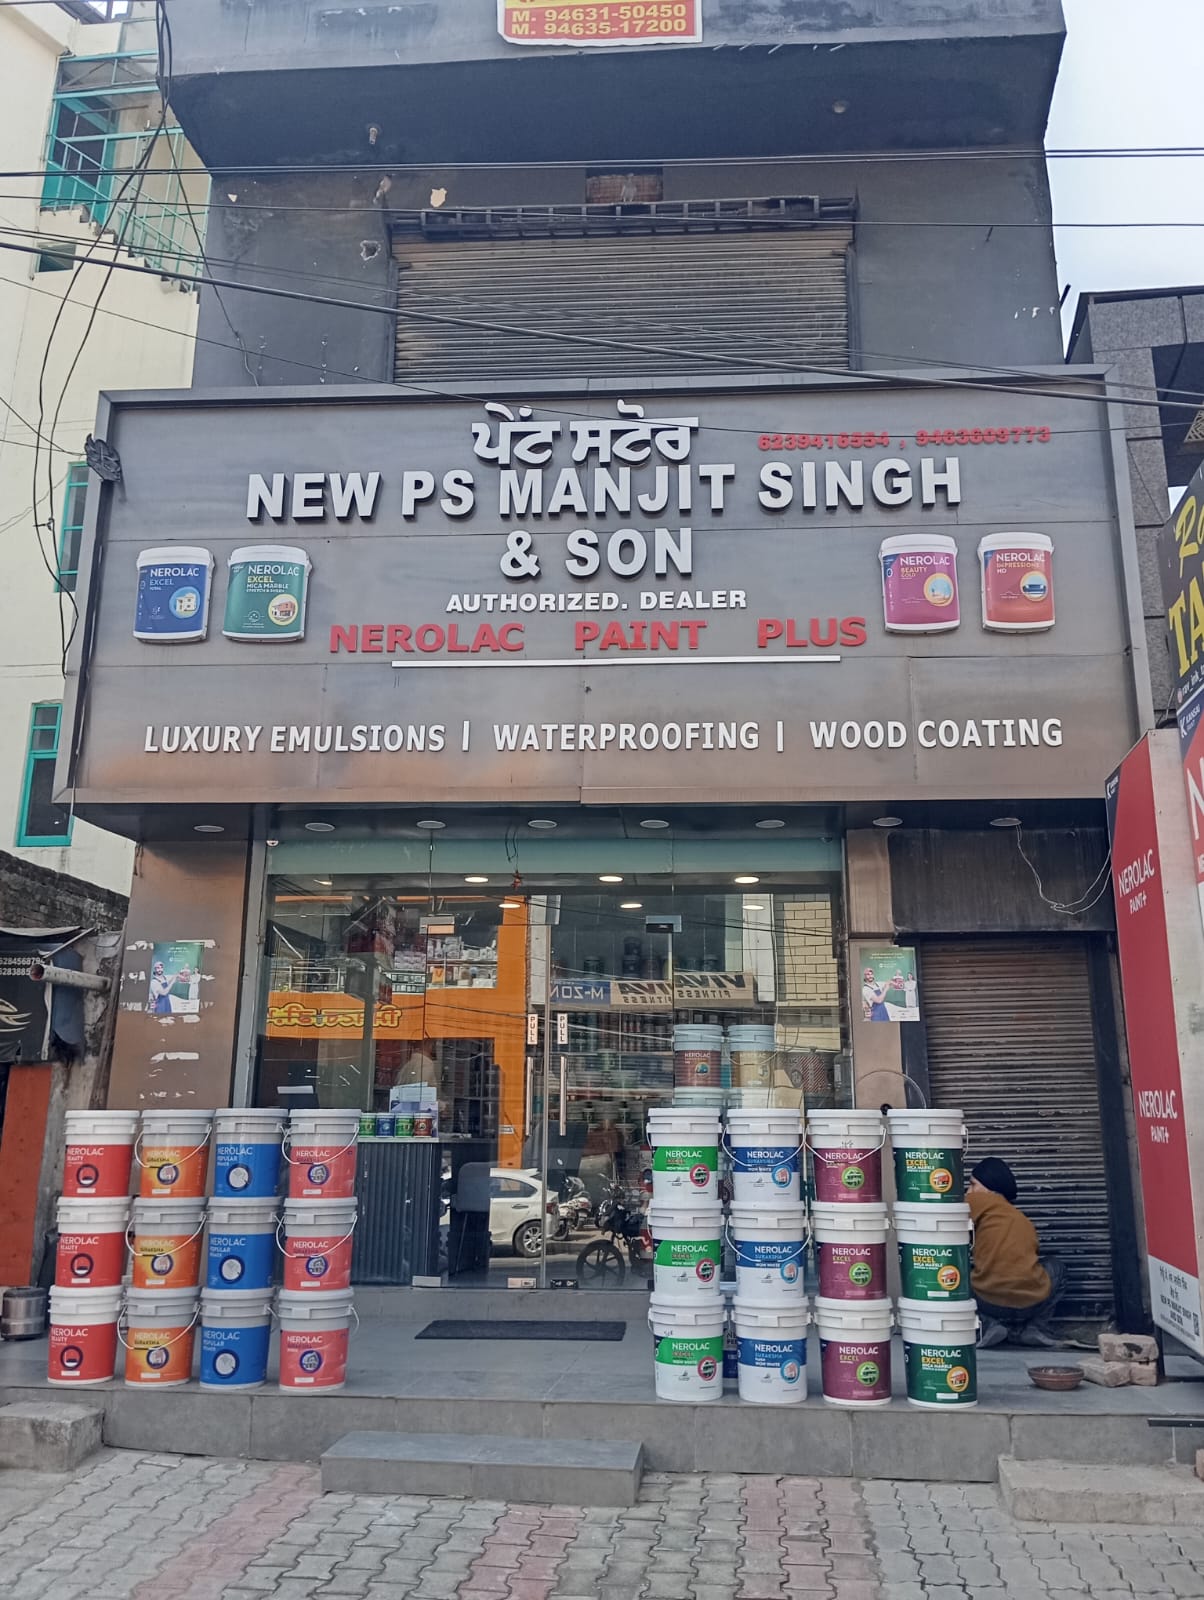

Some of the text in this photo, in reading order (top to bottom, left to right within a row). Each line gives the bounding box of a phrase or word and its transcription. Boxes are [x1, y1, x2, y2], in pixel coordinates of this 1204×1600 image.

[511, 4, 687, 23] M. 94631-50450
[511, 19, 687, 36] M. 94635-17200
[246, 456, 962, 518] NEW PS MANJIT SINGH
[500, 527, 693, 579] & SON
[996, 552, 1046, 563] NEROLAC
[900, 555, 950, 567] NEROLAC
[150, 567, 200, 578] NEROLAC
[247, 564, 300, 577] NEROLAC
[900, 566, 928, 574] BEAUTY
[149, 578, 175, 586] EXCEL
[247, 575, 275, 583] EXCEL
[445, 589, 748, 613] AUTHORIZED. DEALER
[329, 616, 868, 653] NEROLAC PAINT PLUS
[144, 725, 263, 753] LUXURY
[270, 724, 447, 753] EMULSIONS
[492, 722, 760, 752] WATERPROOFING
[809, 720, 908, 751] WOOD
[917, 718, 1064, 749] COATING
[1118, 848, 1156, 899] NEROLAC
[1138, 1090, 1178, 1120] NEROLAC
[665, 1150, 703, 1158] NEROLAC
[746, 1151, 785, 1159] NEROLAC
[825, 1152, 864, 1160] NEROLAC
[905, 1151, 945, 1160] NEROLAC
[60, 1236, 99, 1245] NEROLAC
[293, 1241, 329, 1249] NEROLAC
[671, 1244, 708, 1253] NEROLAC
[754, 1245, 793, 1254] NEROLAC
[831, 1247, 872, 1256] NEROLAC
[912, 1248, 953, 1257] NEROLAC
[912, 1256, 936, 1264] EXCEL
[51, 1328, 89, 1337] NEROLAC
[287, 1335, 323, 1344] NEROLAC
[672, 1342, 710, 1350] NEROLAC
[754, 1343, 793, 1353] NEROLAC
[839, 1346, 879, 1355] NEROLAC
[921, 1348, 962, 1357] NEROLAC
[921, 1356, 946, 1364] EXCEL
